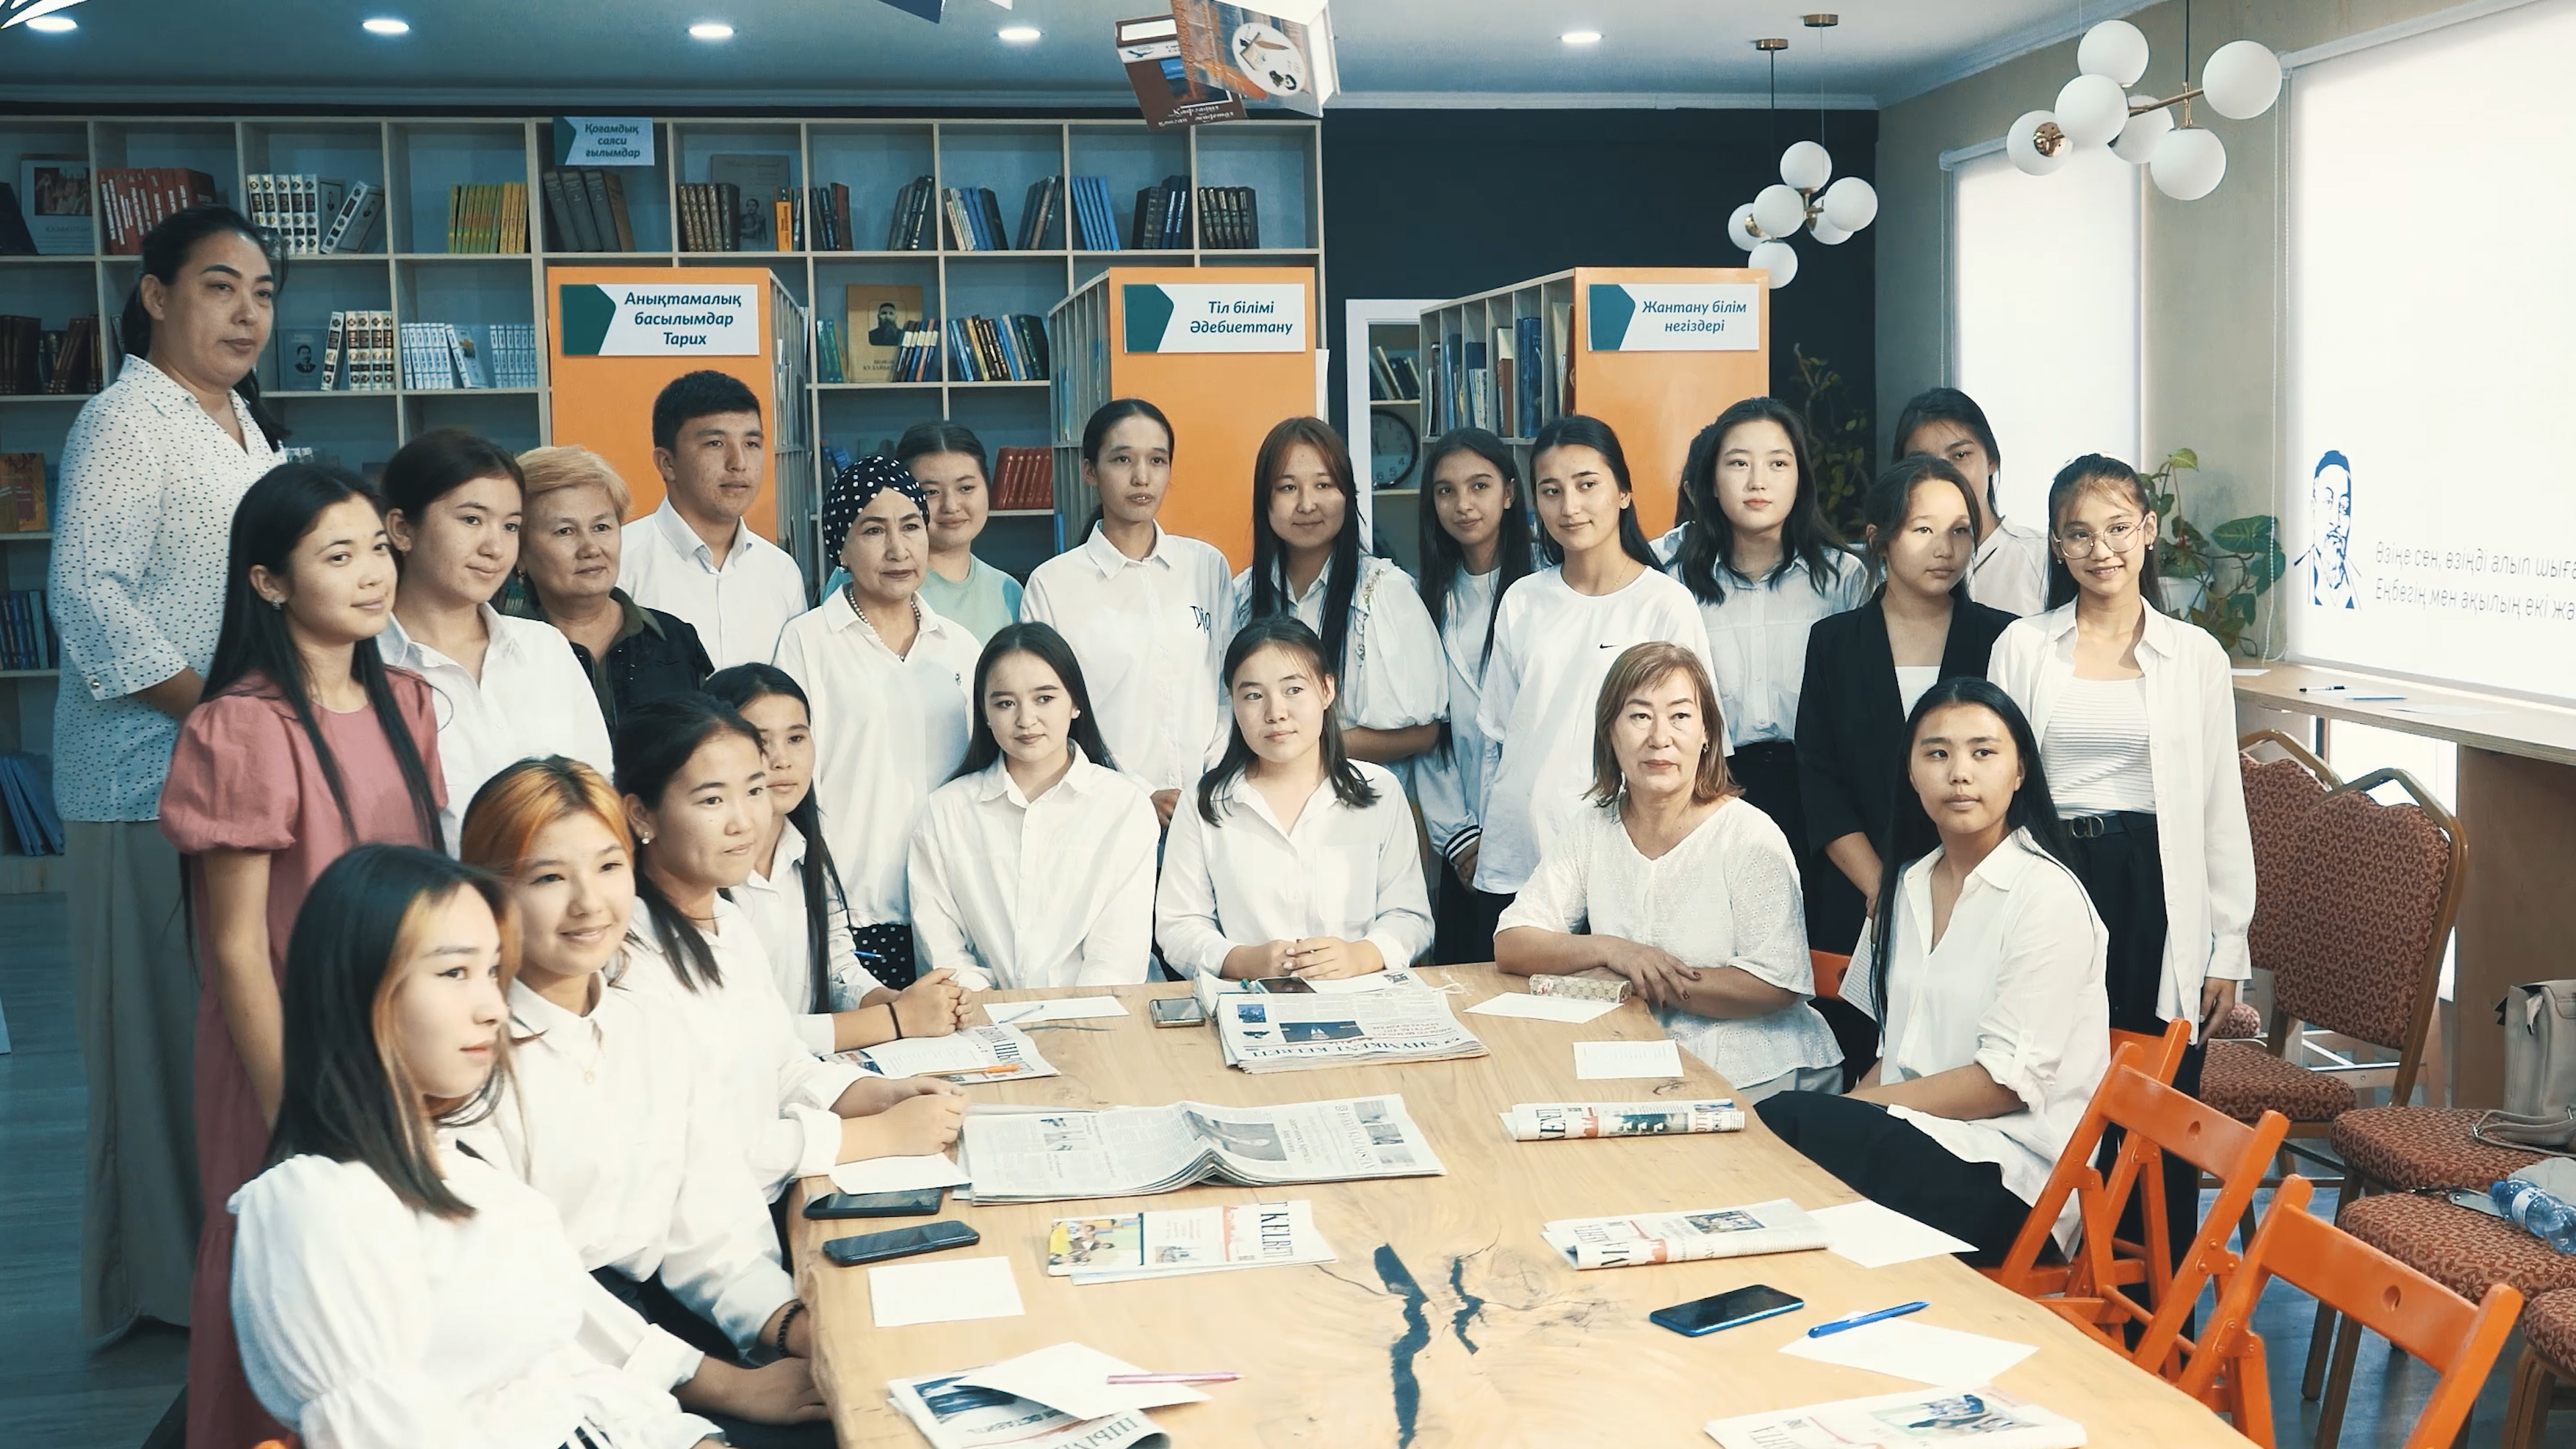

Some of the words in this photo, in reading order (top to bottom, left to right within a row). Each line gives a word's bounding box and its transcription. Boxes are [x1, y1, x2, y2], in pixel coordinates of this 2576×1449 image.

[585, 123, 639, 135] Қоғамдық
[586, 148, 640, 158] ғылымдар
[625, 292, 741, 307] Анықтамалық
[1208, 301, 1230, 313] Тіл
[1234, 301, 1275, 313] білімі
[1642, 301, 1709, 315] Жантану
[1712, 300, 1747, 313] білім
[635, 311, 733, 327] басылымдар
[1665, 319, 1725, 334] негіздері
[1190, 320, 1293, 335] Әдебиеттану
[663, 332, 706, 347] Тарих
[2376, 541, 2411, 570] Өзіңе
[2446, 546, 2487, 576] өзіңді
[2491, 555, 2530, 574] алып
[2376, 578, 2426, 610] Еңбегің
[2430, 588, 2457, 606] мен
[2461, 591, 2521, 620] ақылың
[2525, 594, 2548, 617] екі
[1260, 1212, 1294, 1258] KELBETI
